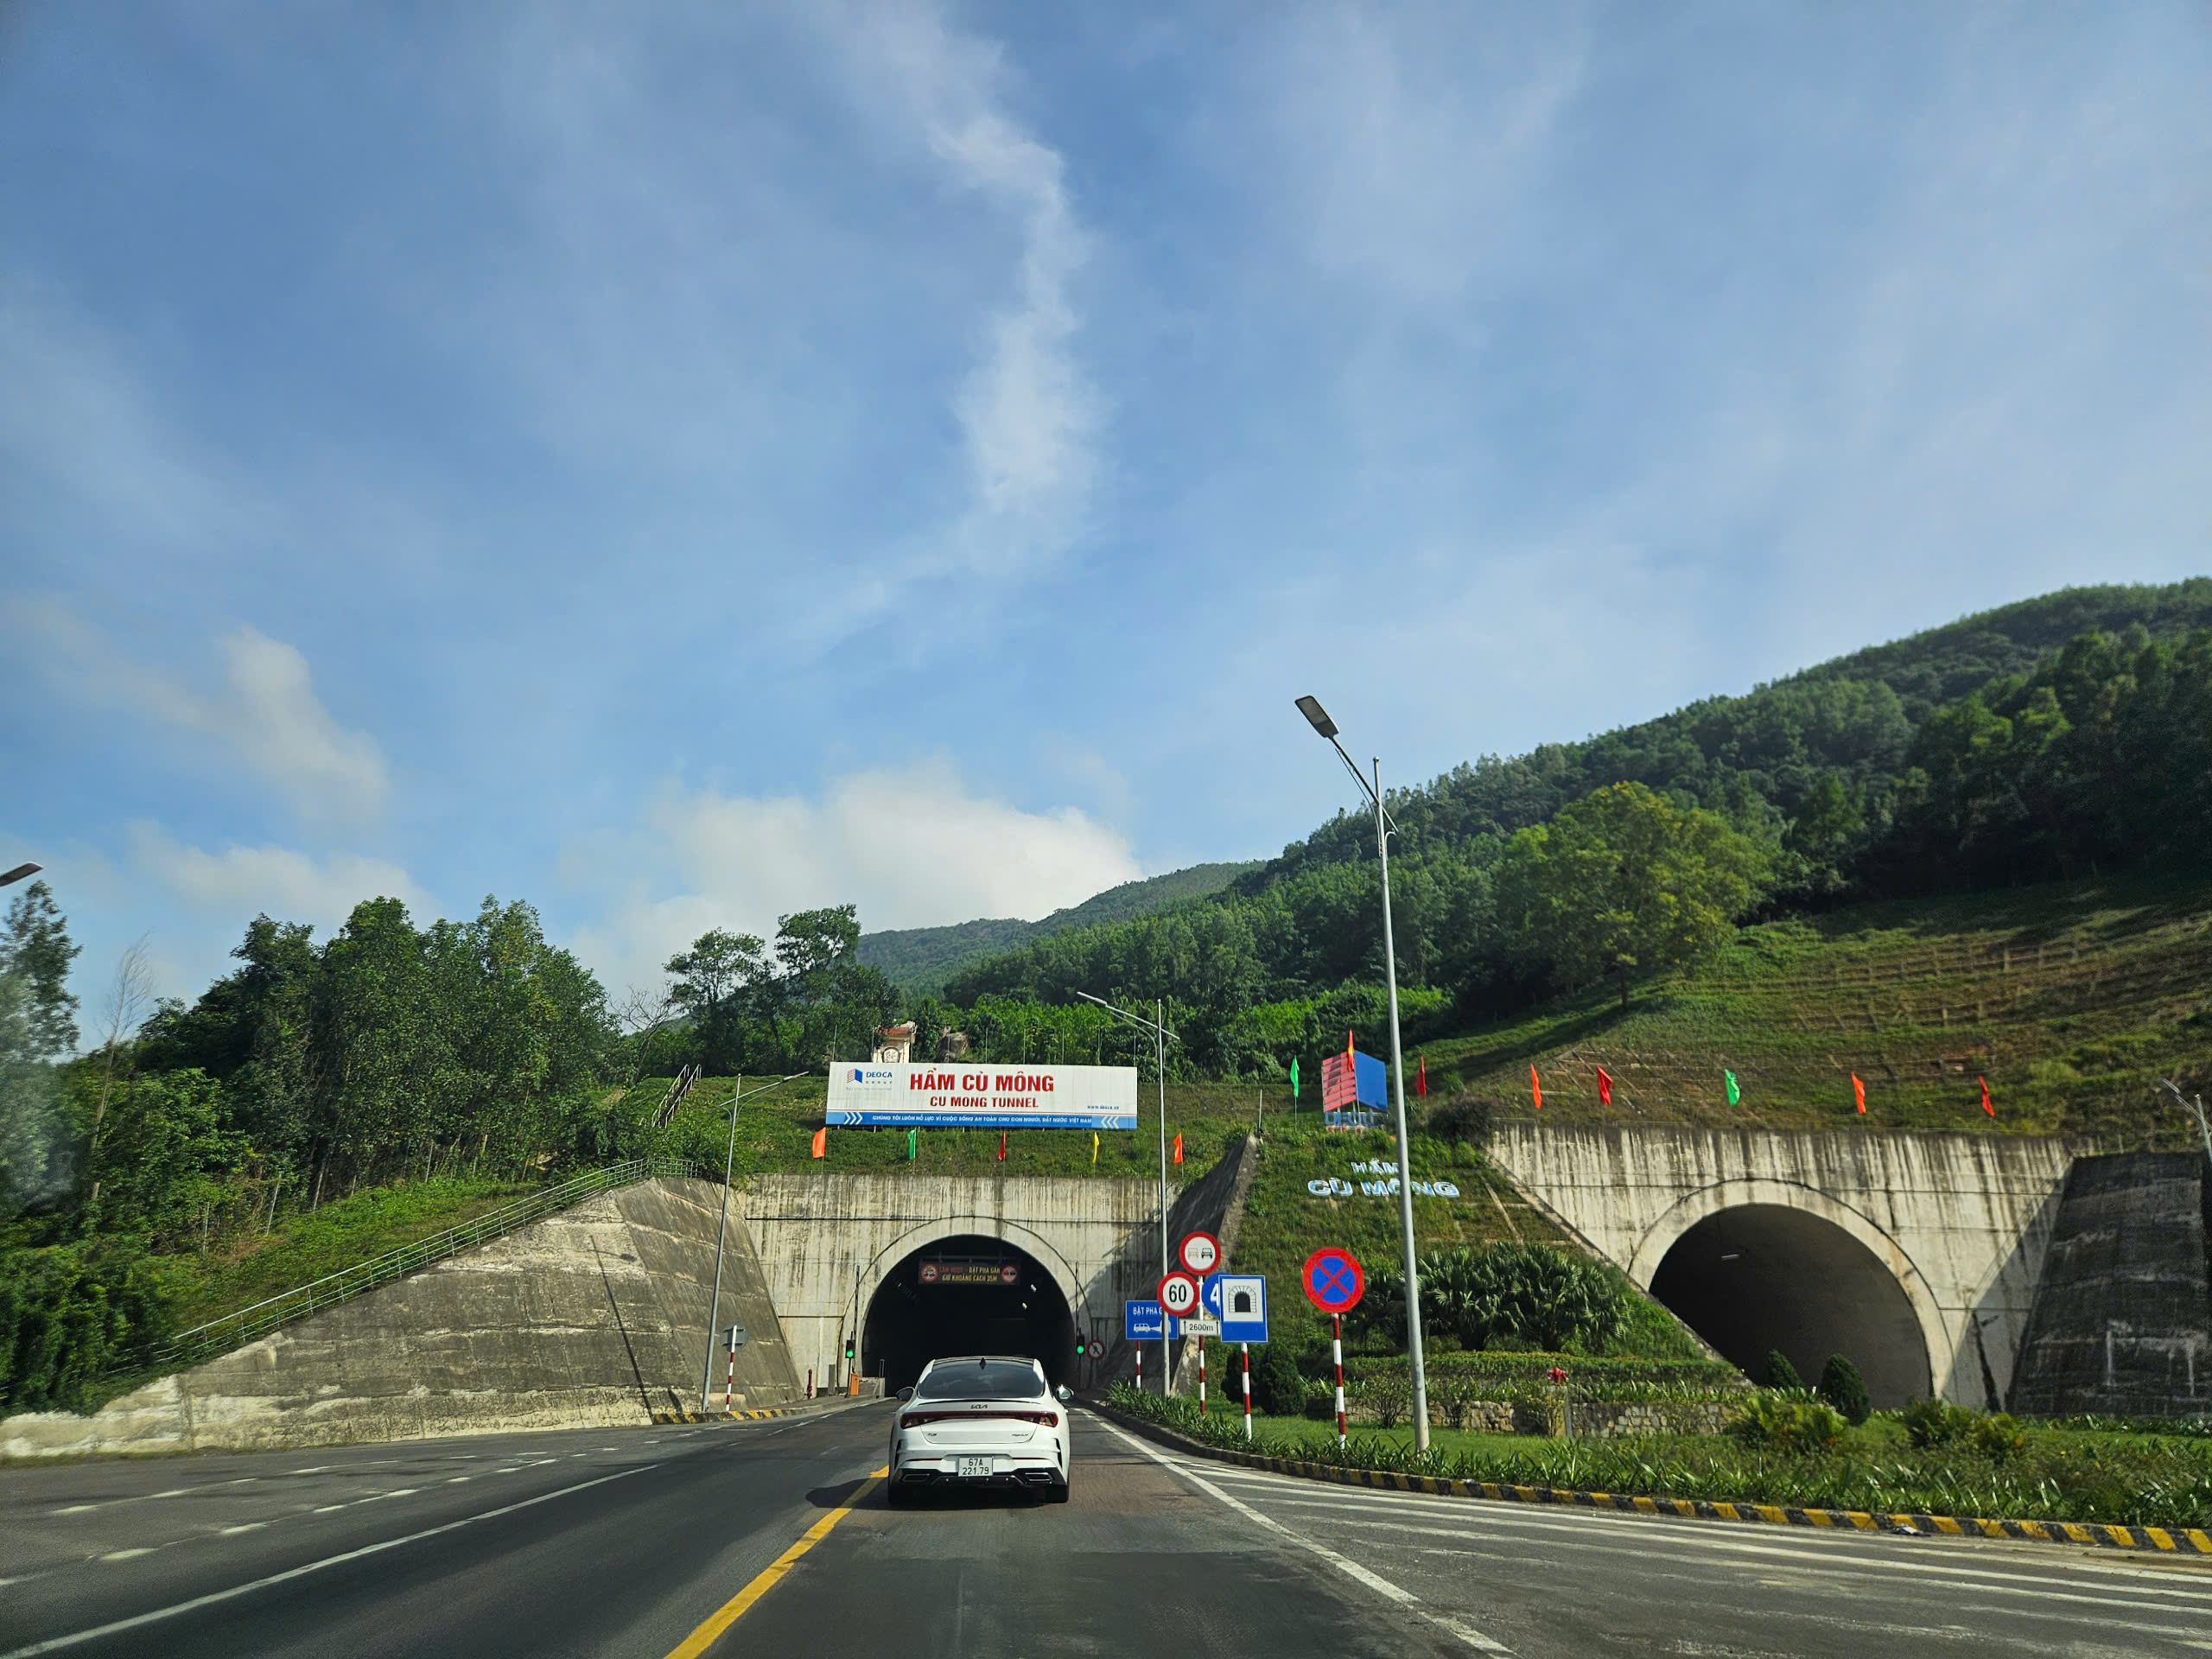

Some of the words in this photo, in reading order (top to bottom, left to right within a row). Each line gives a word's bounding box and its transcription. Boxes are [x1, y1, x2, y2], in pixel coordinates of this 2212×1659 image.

[910, 1067, 956, 1090] HẦM
[962, 1071, 988, 1092] CÙ
[995, 1071, 1054, 1092] MÔNG
[930, 1096, 946, 1107] CU
[950, 1096, 988, 1108] MONG
[991, 1097, 1039, 1108] TUNNEL
[1168, 1284, 1187, 1303] 60
[1210, 1283, 1219, 1307] 4
[1146, 1306, 1158, 1315] PHA
[1189, 1323, 1214, 1332] 2600m
[969, 1458, 983, 1466] 67A
[963, 1466, 989, 1475] 221.79
